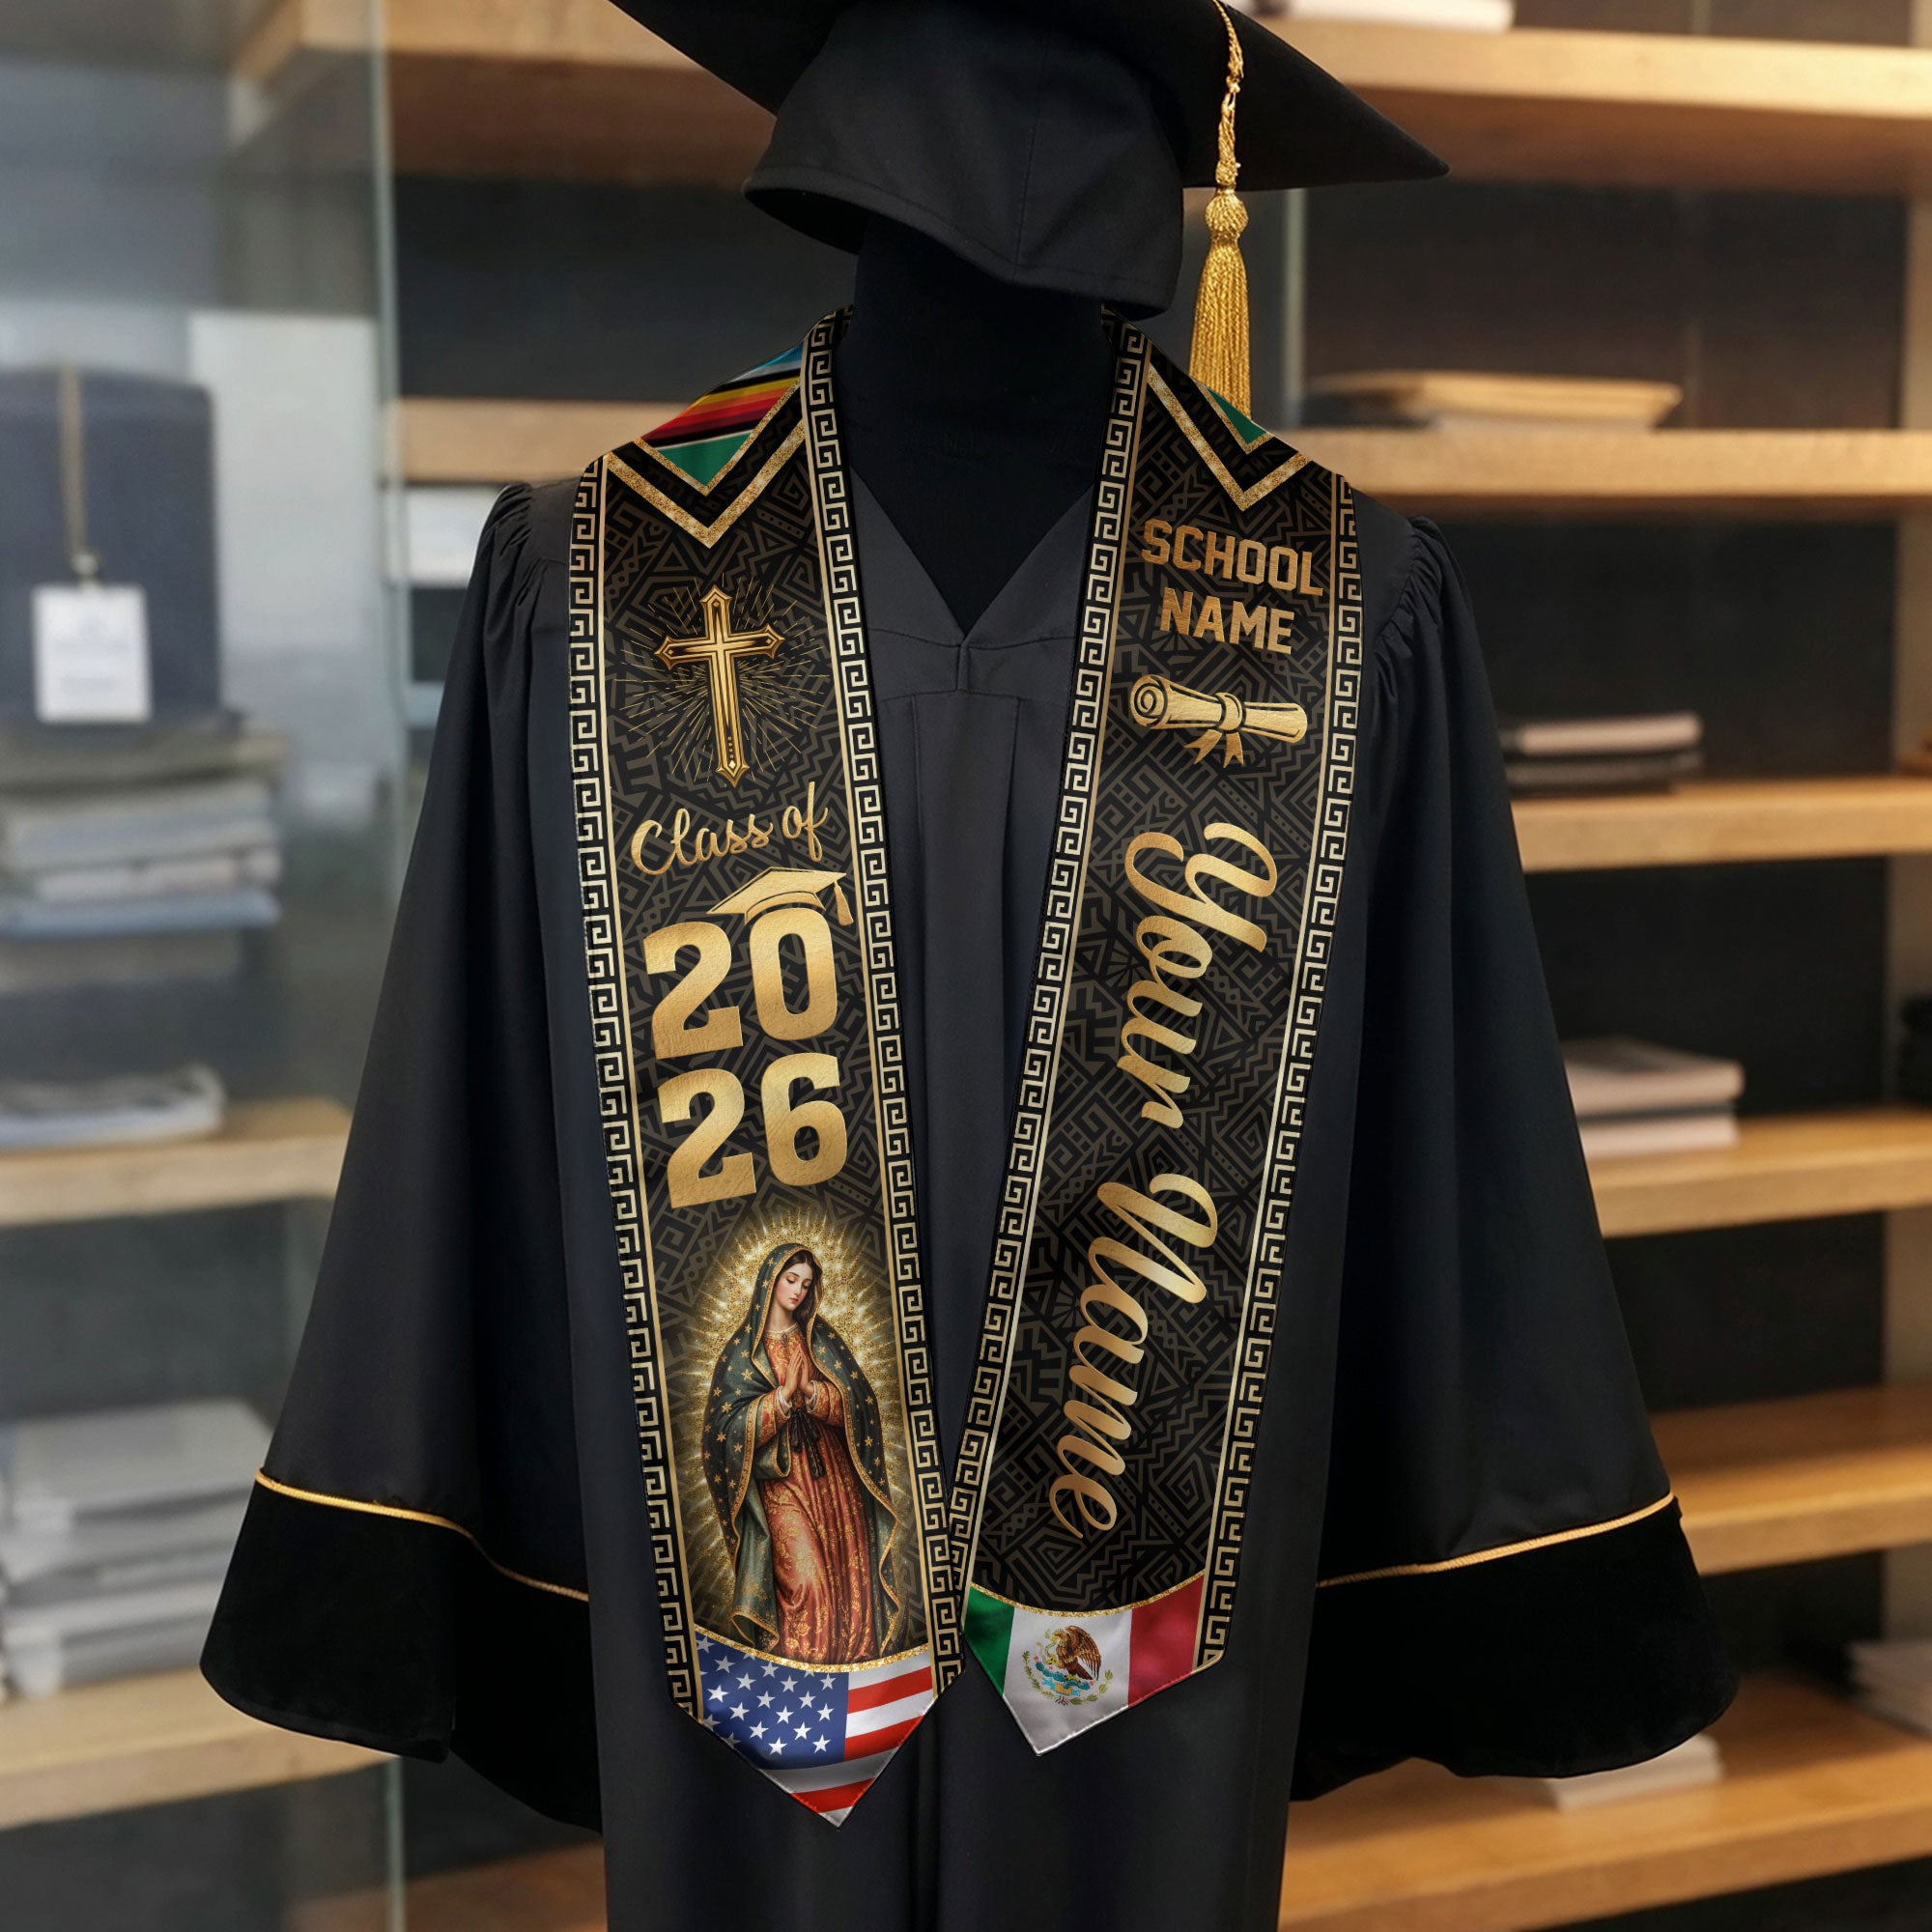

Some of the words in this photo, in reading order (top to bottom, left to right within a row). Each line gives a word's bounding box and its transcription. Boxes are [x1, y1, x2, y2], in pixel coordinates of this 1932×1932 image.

[1141, 519, 1323, 596] SCHOOL
[1160, 586, 1294, 655] NAME
[631, 808, 773, 875] Class
[782, 781, 828, 863] of
[1117, 822, 1276, 1129] Your
[1048, 1173, 1217, 1539] Name
